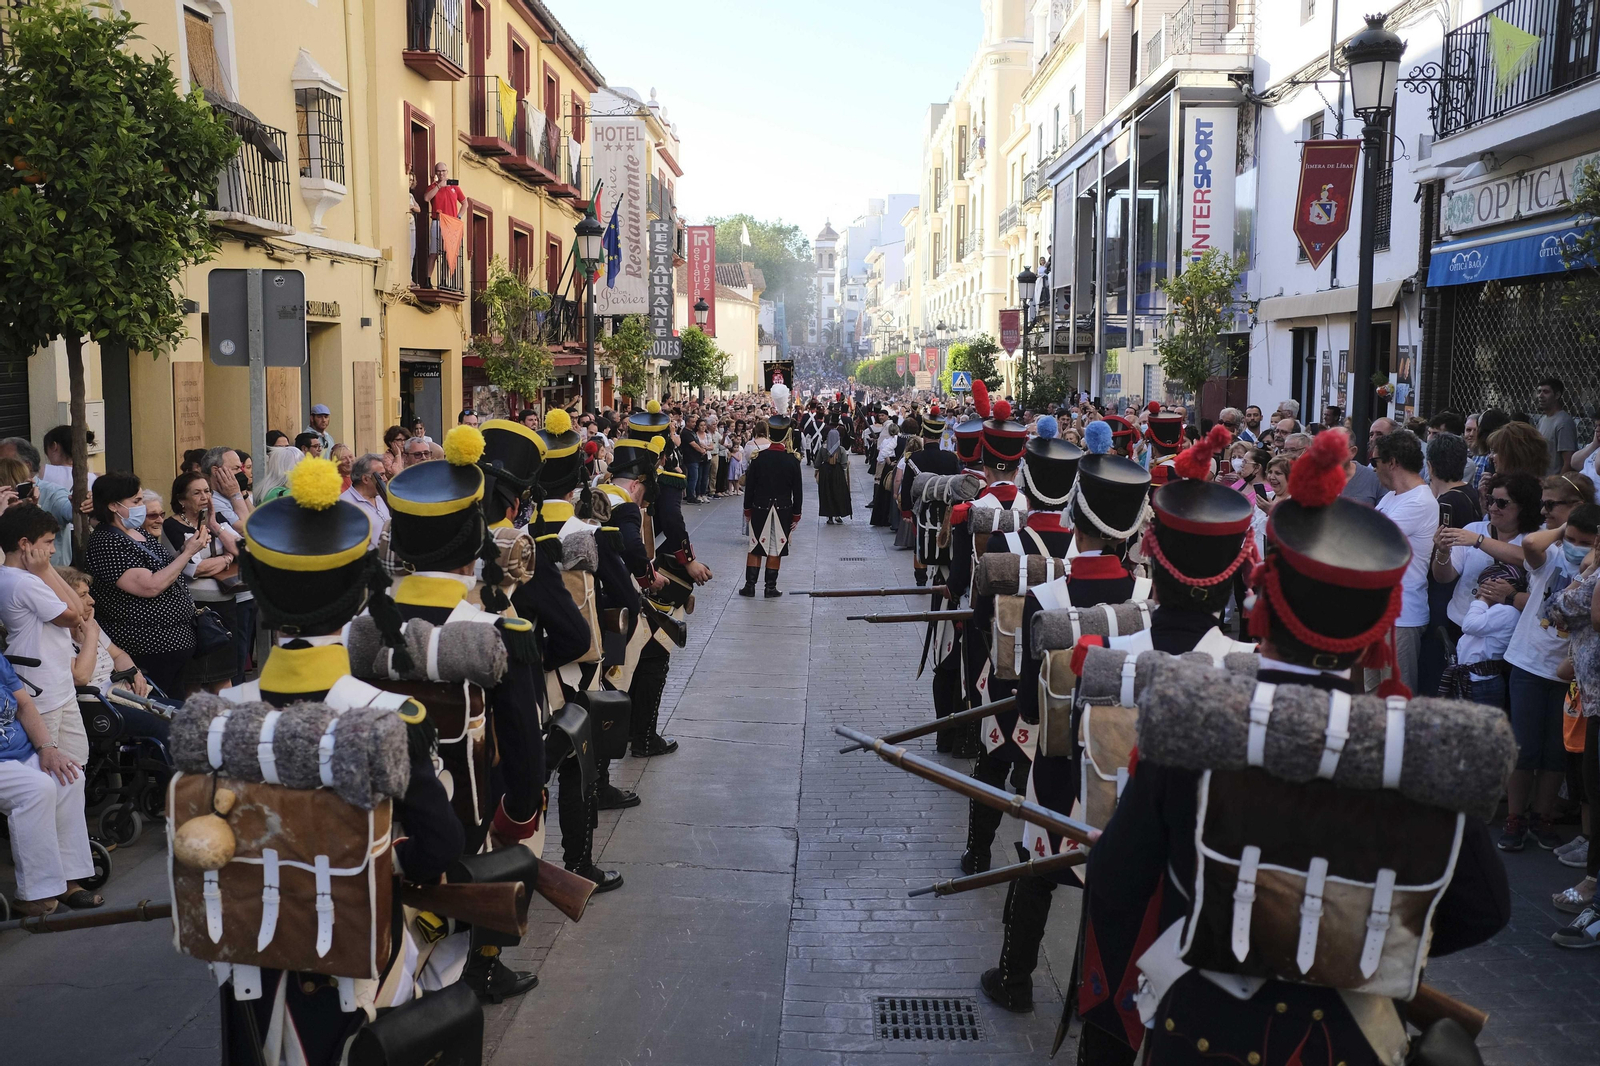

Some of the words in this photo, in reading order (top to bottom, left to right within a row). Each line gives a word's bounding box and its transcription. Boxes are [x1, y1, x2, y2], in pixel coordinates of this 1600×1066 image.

[594, 126, 645, 142] HOTEL
[1192, 118, 1213, 255] INTERSPORT
[1477, 165, 1570, 223] OPTICA
[624, 154, 642, 279] Restaurante
[653, 222, 669, 338] RESTAURANTE
[703, 247, 711, 291] Jerez
[599, 286, 646, 312] Javier
[647, 341, 680, 356] LORES
[989, 728, 1000, 744] 4
[1017, 729, 1029, 744] 3
[1034, 837, 1045, 857] 4
